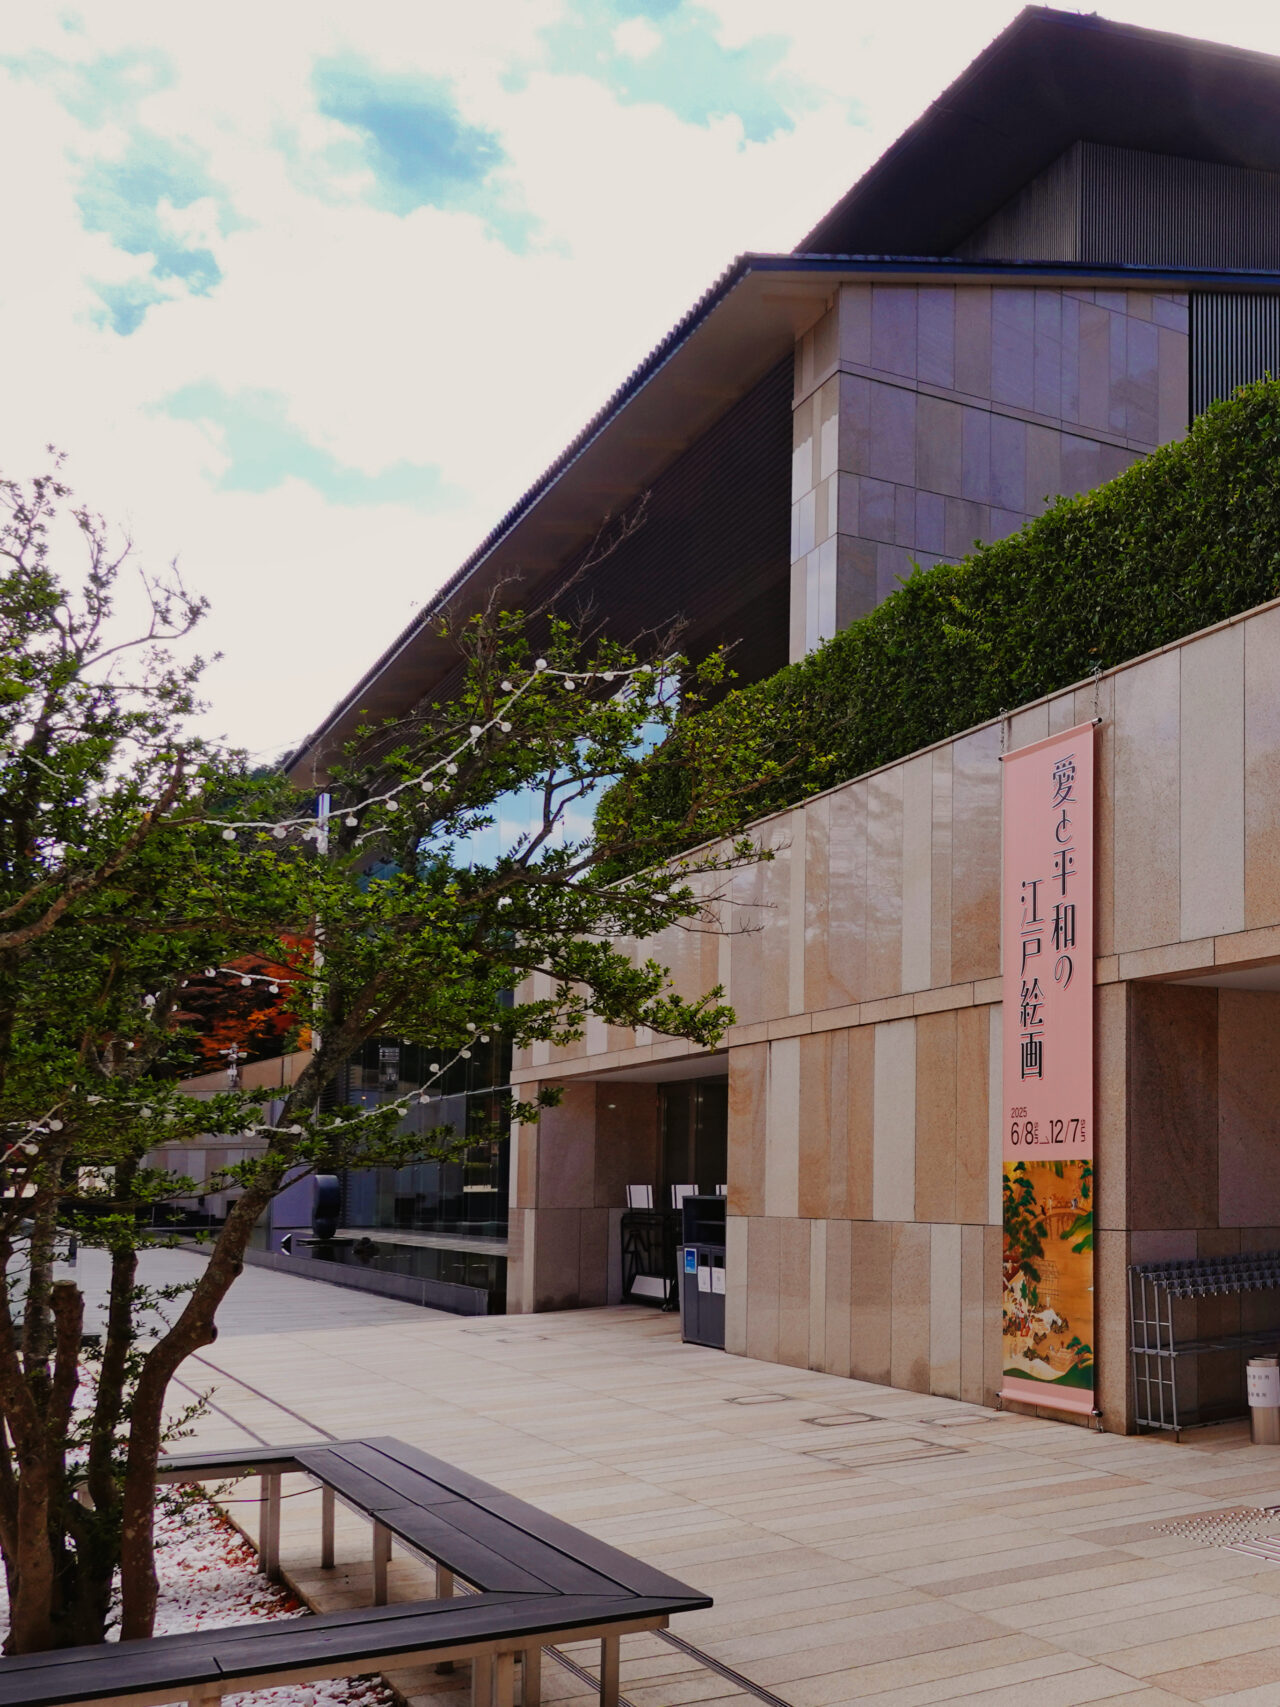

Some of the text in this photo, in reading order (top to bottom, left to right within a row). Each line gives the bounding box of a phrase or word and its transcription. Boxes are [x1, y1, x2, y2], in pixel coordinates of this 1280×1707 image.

[1051, 753, 1077, 989] 愛と平和の
[1020, 880, 1044, 1080] 江戸絵画
[1011, 1106, 1028, 1118] 2025
